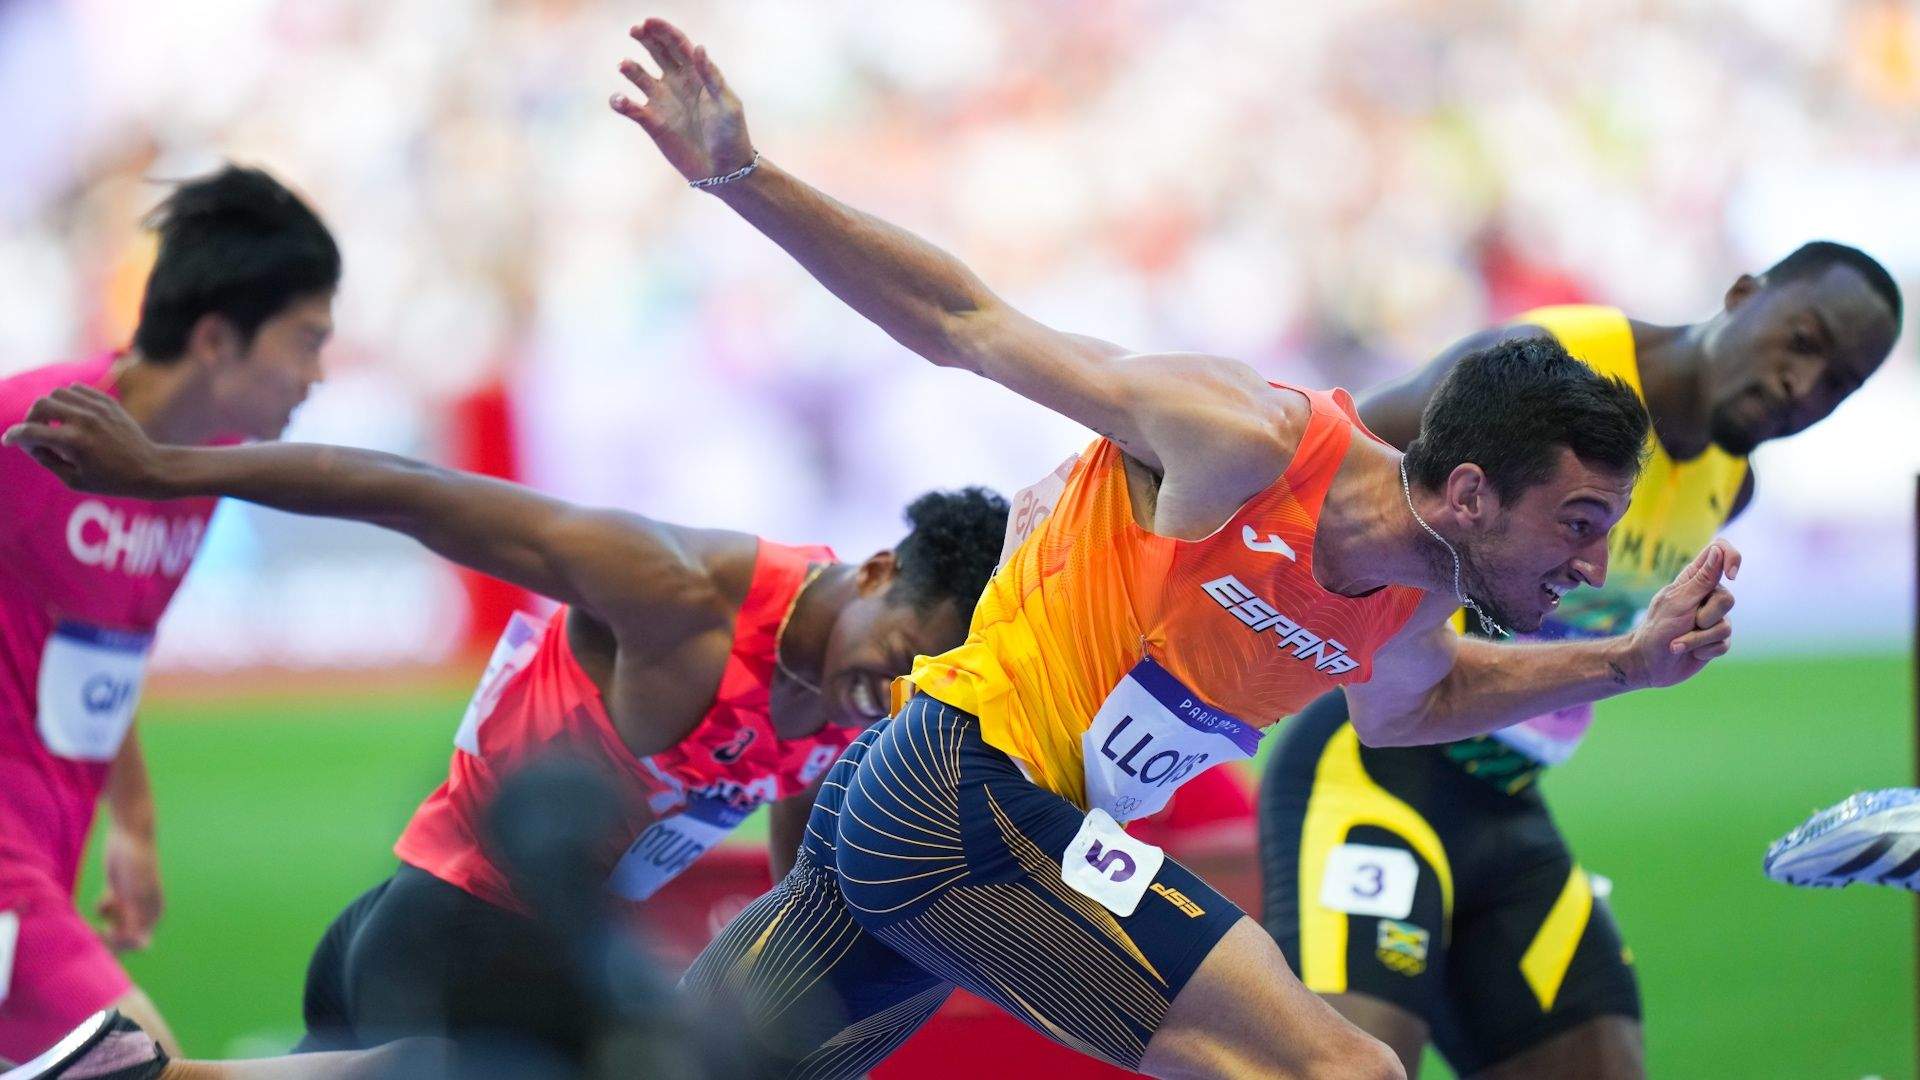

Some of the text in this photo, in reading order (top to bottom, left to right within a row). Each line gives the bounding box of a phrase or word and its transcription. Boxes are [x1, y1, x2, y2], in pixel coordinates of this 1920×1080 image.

[1200, 574, 1360, 675] ESPAÑA
[1179, 698, 1217, 728] PARIS
[1085, 838, 1137, 883] 5
[1351, 863, 1384, 899] 3
[1149, 882, 1206, 918] ESP
